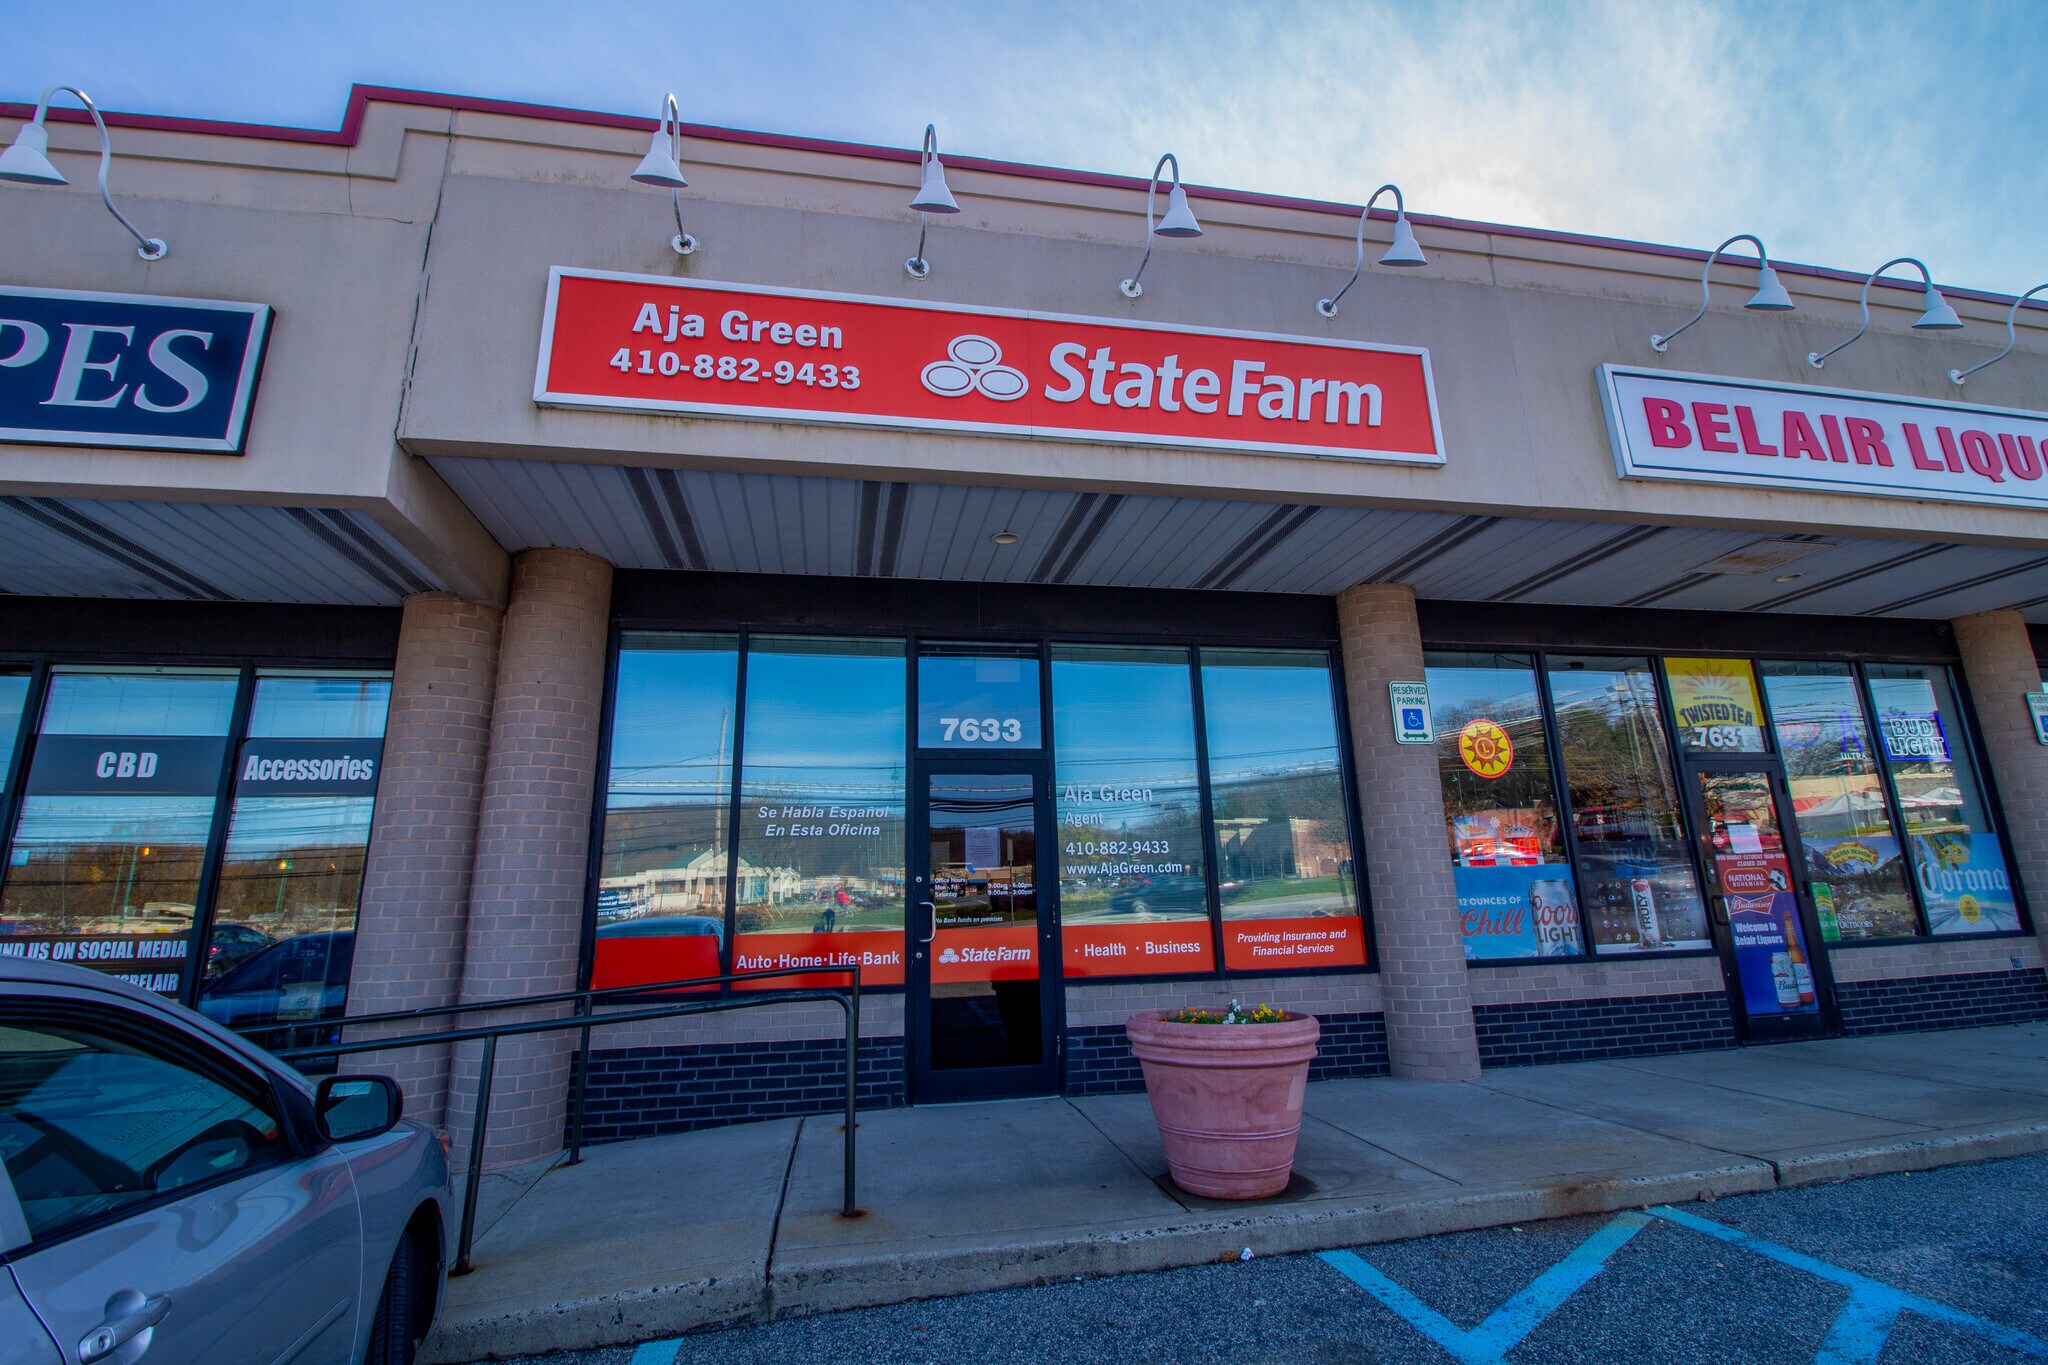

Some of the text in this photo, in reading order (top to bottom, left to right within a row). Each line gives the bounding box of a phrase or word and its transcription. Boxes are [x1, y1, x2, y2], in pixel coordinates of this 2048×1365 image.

[632, 302, 842, 349] Aja Green
[609, 347, 861, 390] 410-882-9433
[1902, 422, 2048, 483] LIQU
[1393, 686, 1426, 694] RESERVED
[1397, 697, 1425, 705] PARKING
[1679, 703, 1753, 728] TWISTED TEA
[940, 717, 1022, 742] 7633
[1889, 718, 1933, 736] BUD
[1694, 726, 1745, 747] 7631
[1887, 737, 1944, 755] LIGHT
[96, 752, 159, 779] CBD
[243, 754, 374, 782] Accessories
[1064, 785, 1153, 806] Aja Green
[758, 806, 889, 820] Se Habla Español
[1065, 811, 1104, 827] Agent
[765, 824, 880, 836] En Esta Oficina
[1065, 841, 1170, 855] 410-882-9433
[1066, 862, 1183, 876] www.AjaGreen.com
[1728, 874, 1765, 882] NATIONAL
[1917, 861, 2009, 900] Corona
[1470, 896, 1507, 906] OUNCES
[1509, 896, 1521, 904] OF
[1641, 894, 1652, 931] TRULY
[1459, 907, 1526, 937] Chill
[1734, 922, 1777, 932] Welcome to
[1238, 929, 1347, 944] Providing Insurance and
[1734, 934, 1784, 946] Belair Liquors
[52, 941, 77, 960] ON
[78, 940, 135, 960] SOCIAL
[137, 940, 188, 958] MEDIA
[1084, 941, 1200, 957] Health Business
[1253, 943, 1334, 956] Financial Services
